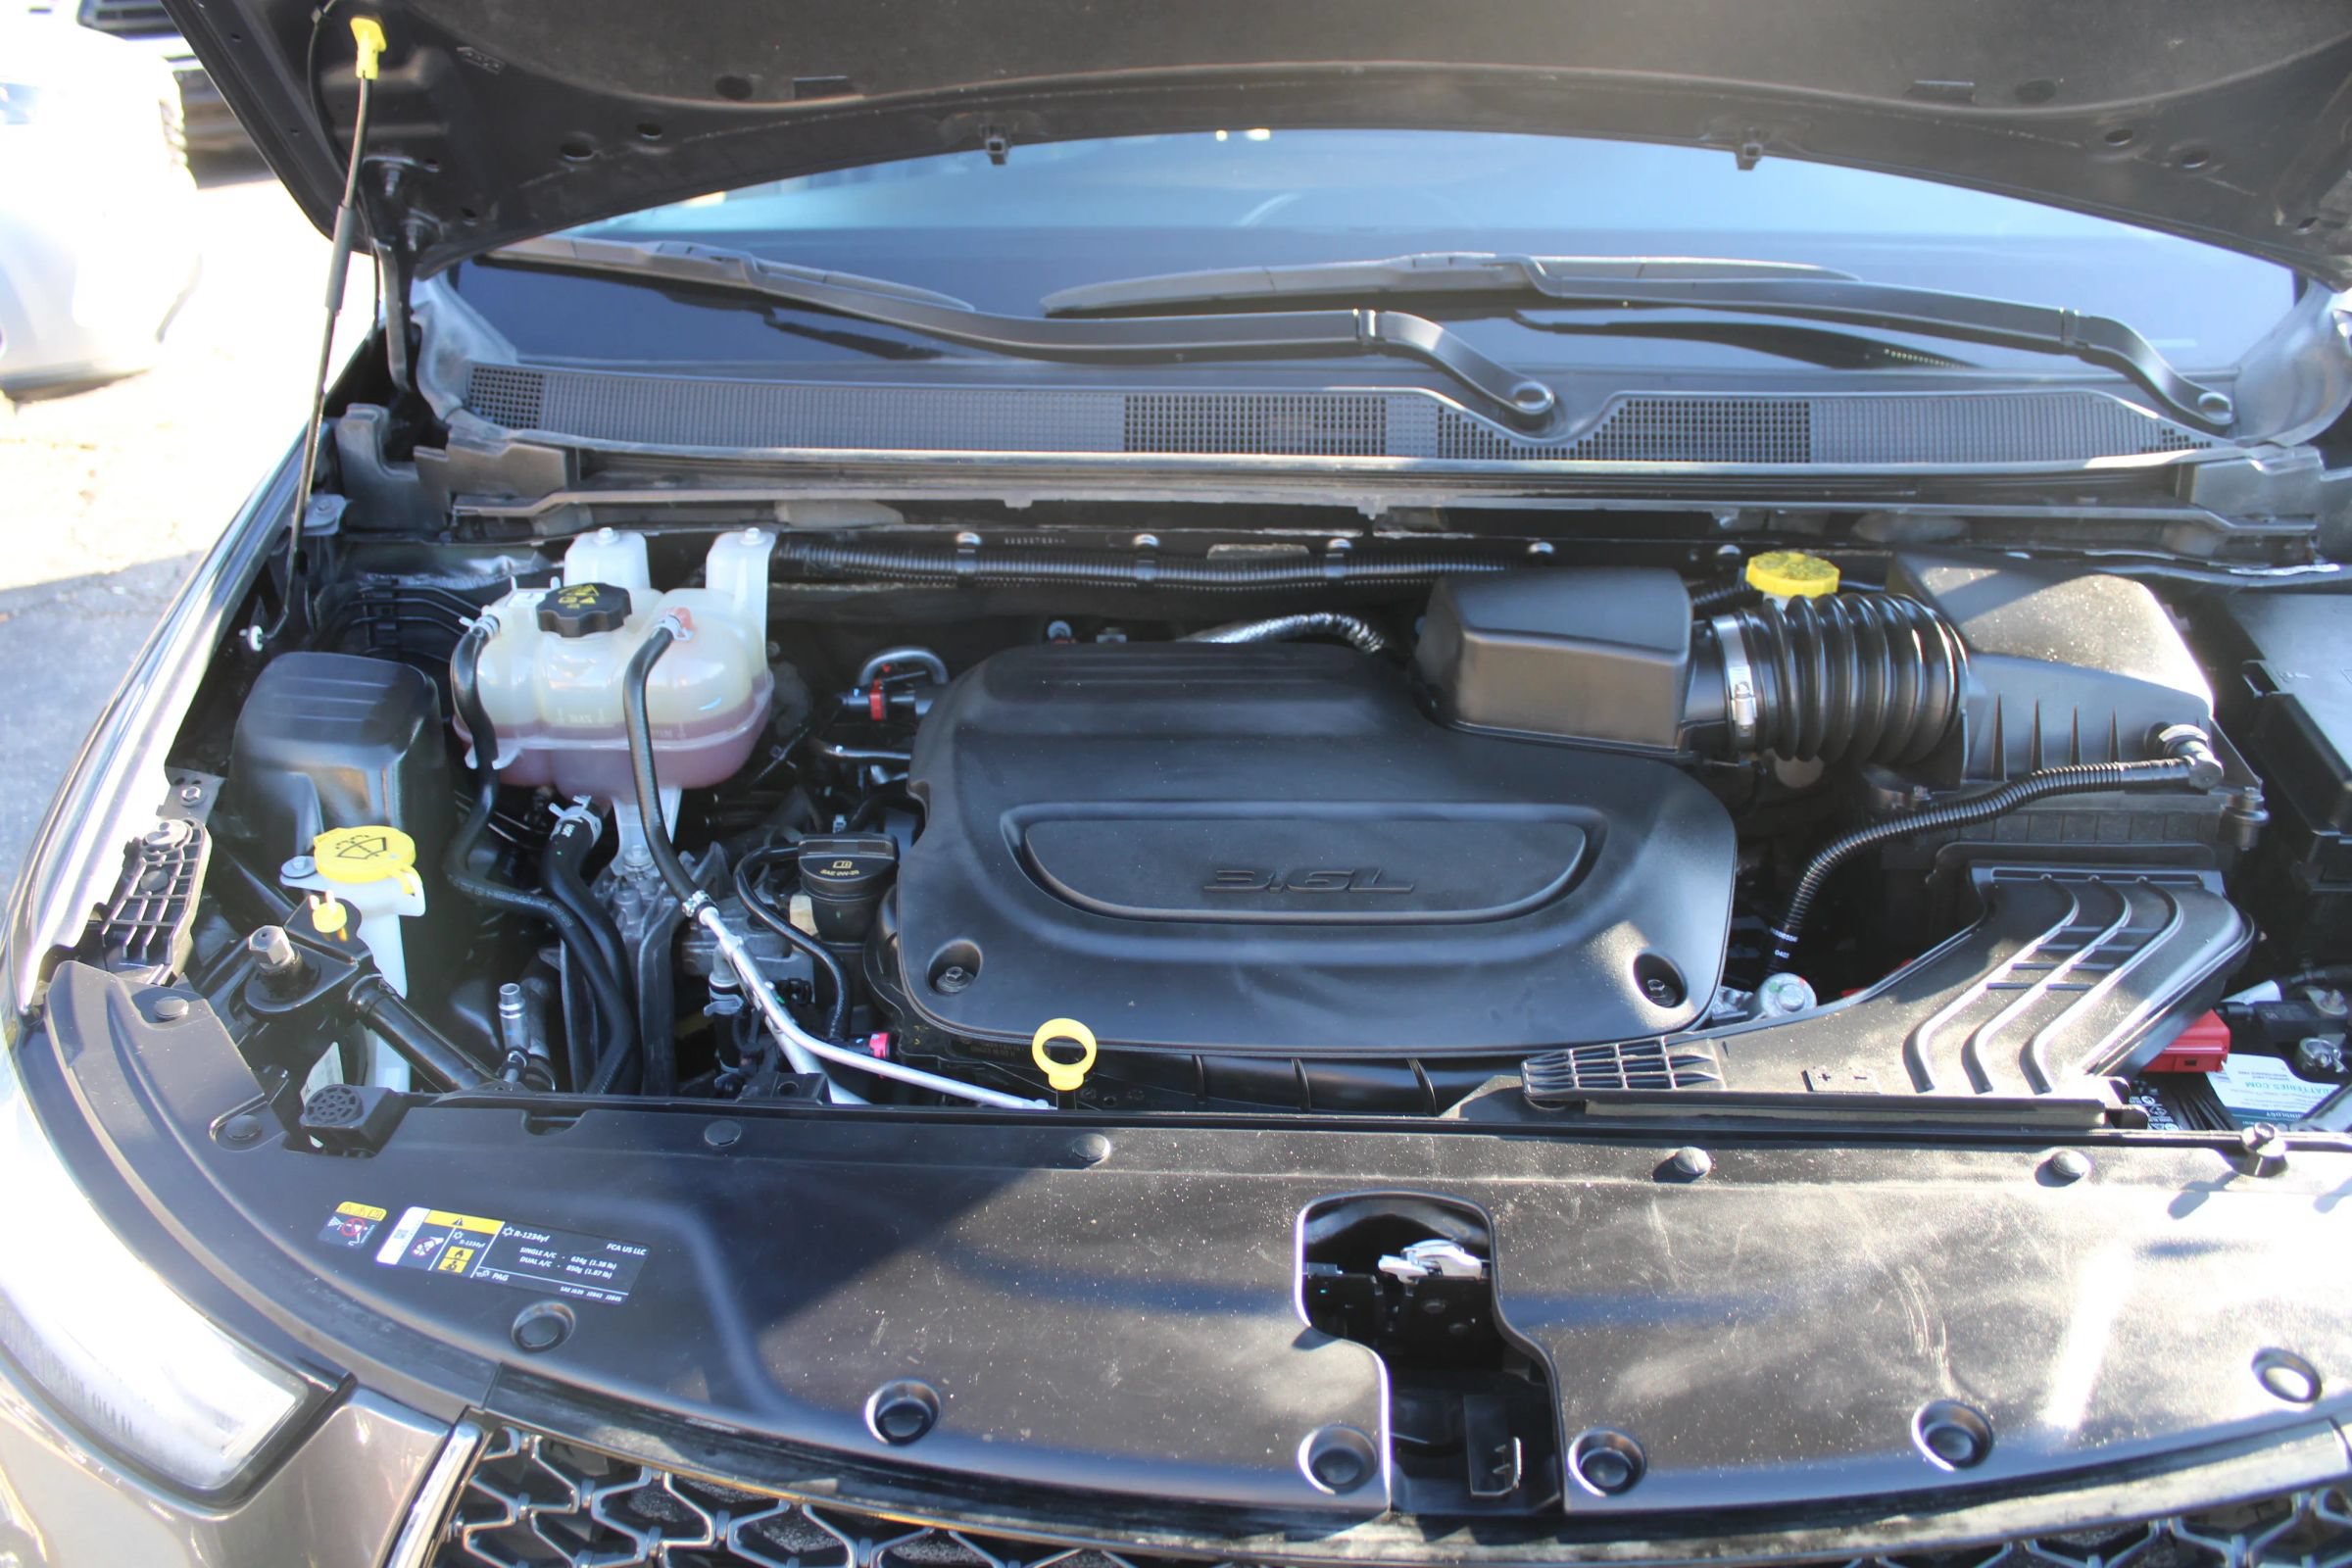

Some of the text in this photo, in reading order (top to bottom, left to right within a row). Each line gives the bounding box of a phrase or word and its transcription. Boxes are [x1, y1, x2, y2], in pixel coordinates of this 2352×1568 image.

[1203, 867, 1414, 894] 3.6L
[514, 1230, 551, 1244] R-1234yf
[519, 1247, 543, 1256] SINGLE
[607, 1243, 621, 1251] FCA
[519, 1255, 538, 1265] DUAL
[538, 1258, 553, 1267] A/C
[492, 1272, 510, 1282] PAG
